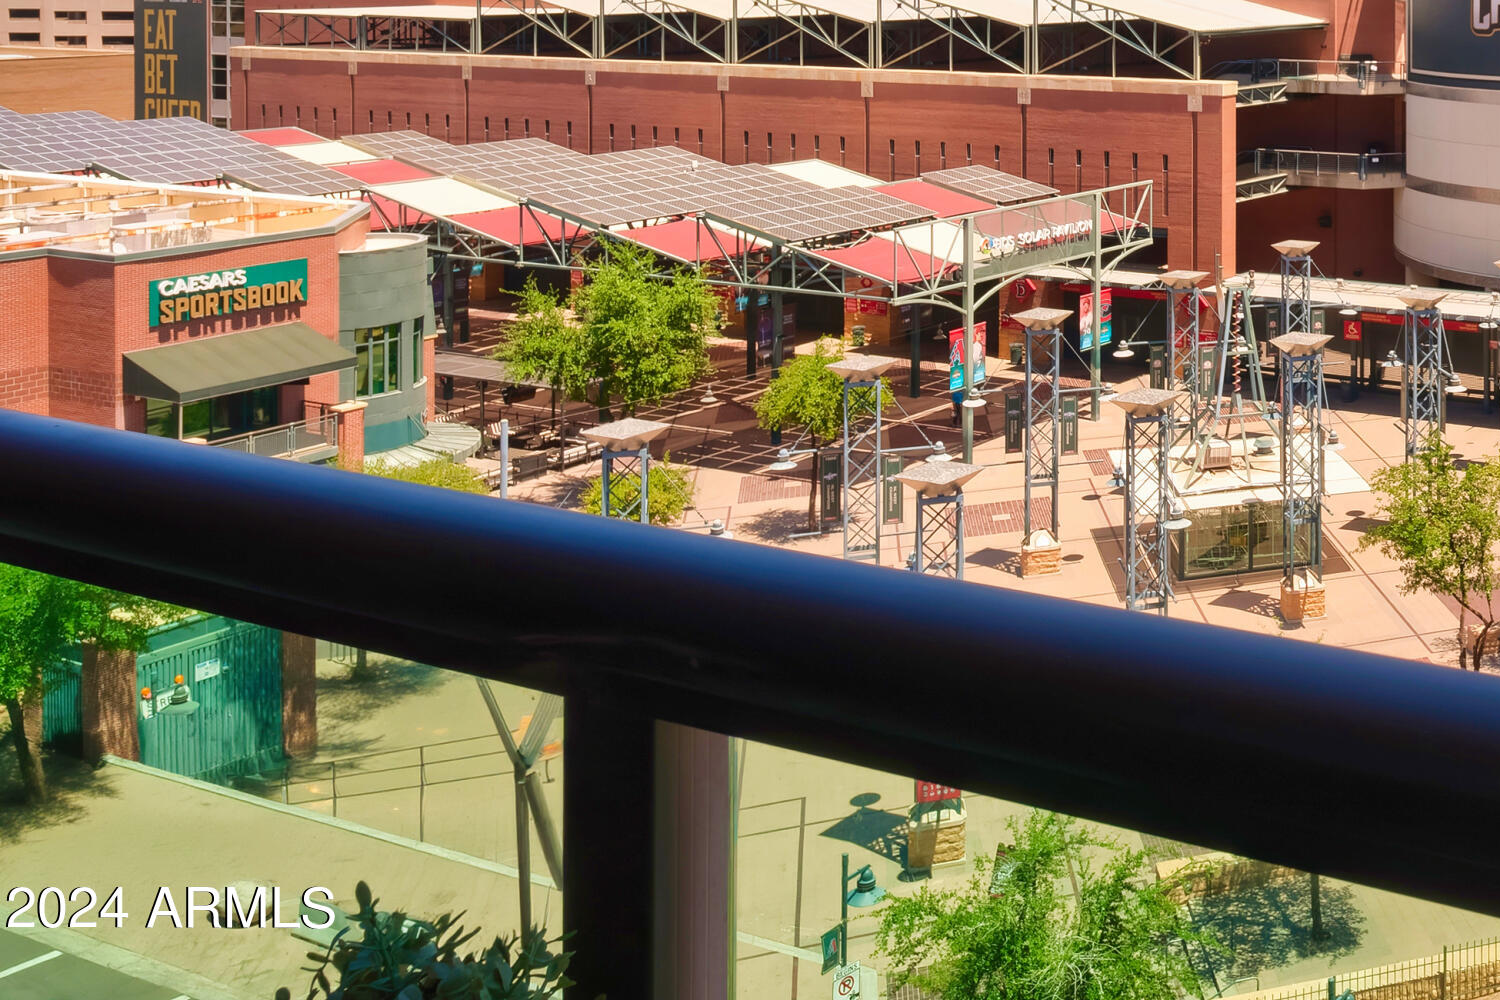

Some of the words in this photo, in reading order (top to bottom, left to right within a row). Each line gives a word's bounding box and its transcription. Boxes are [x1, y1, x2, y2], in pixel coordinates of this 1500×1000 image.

[144, 9, 177, 50] EAT
[144, 53, 178, 95] BET
[1017, 228, 1051, 245] SOLAR
[1050, 219, 1093, 238] PAVILION
[157, 269, 248, 297] CAESARS
[159, 278, 304, 324] SPORTSBOOK
